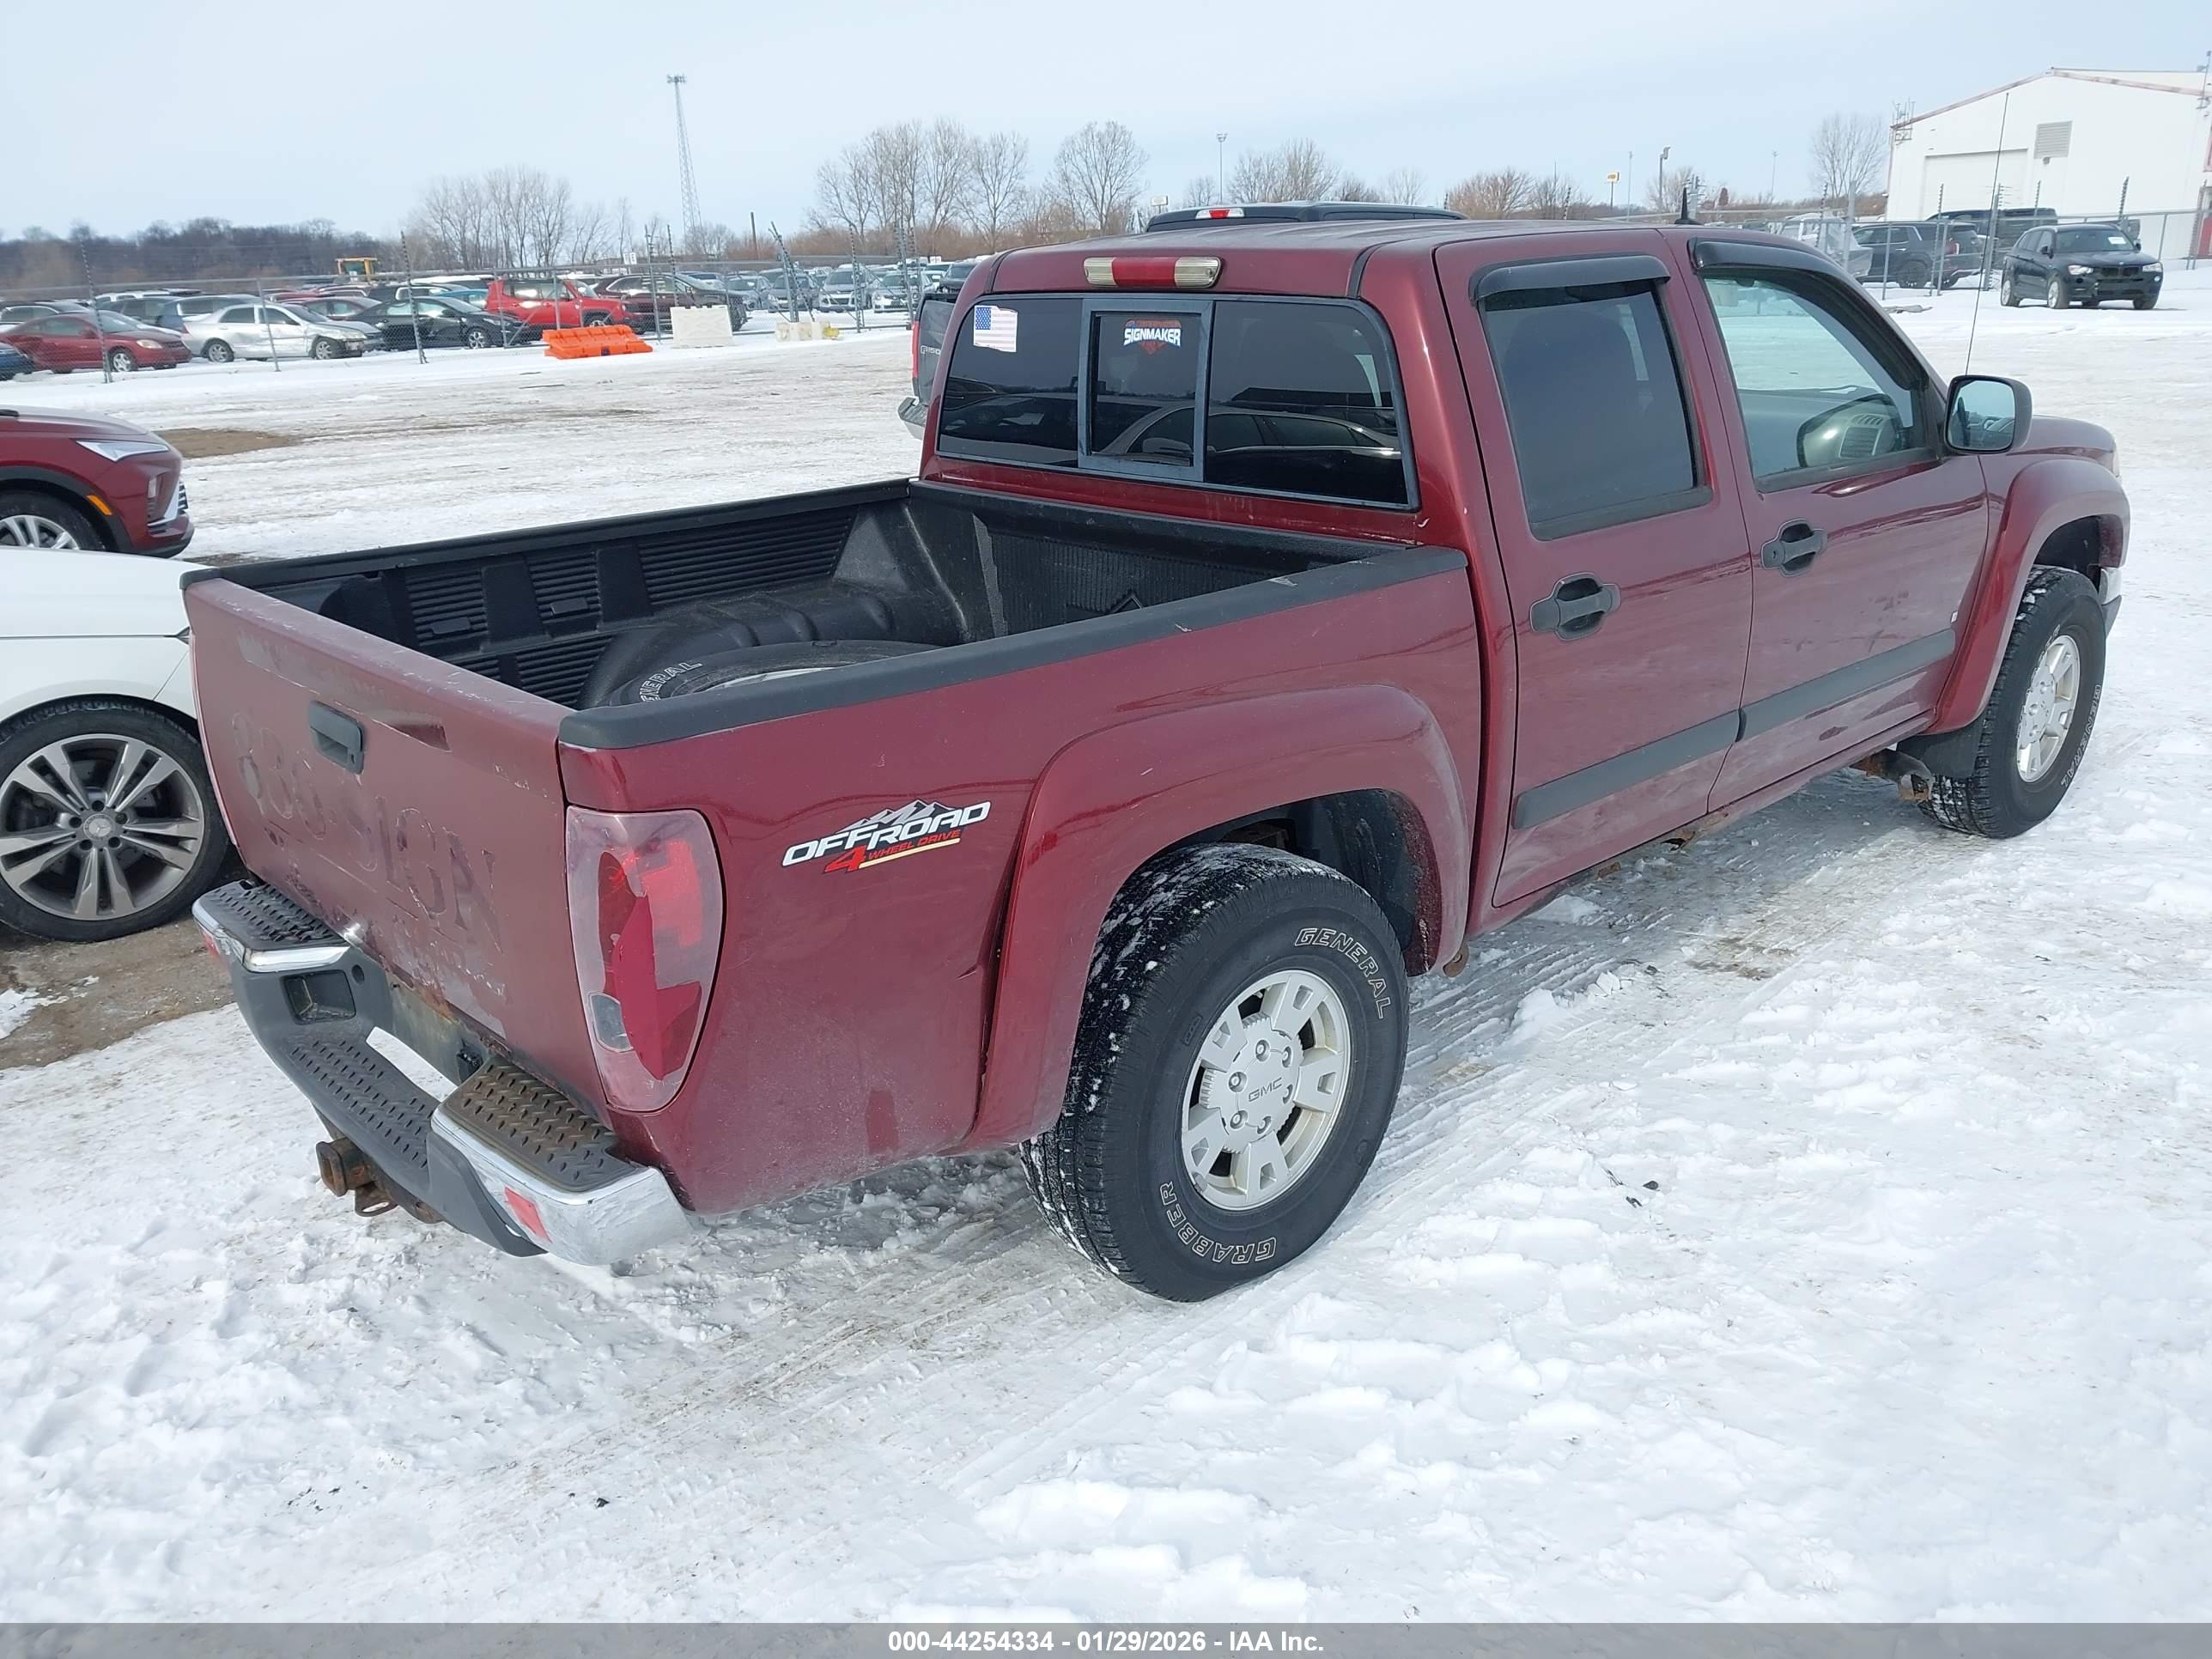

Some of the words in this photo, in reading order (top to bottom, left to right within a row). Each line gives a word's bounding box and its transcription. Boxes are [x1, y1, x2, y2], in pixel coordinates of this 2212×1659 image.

[1123, 327, 1182, 348] SIGNMAKER
[781, 800, 992, 867] OFFROAD
[823, 845, 867, 874] 4
[868, 842, 915, 860] WHEEL
[916, 829, 962, 847] DRIVE
[1294, 927, 1391, 1021] GENERAL
[1248, 1077, 1283, 1103] GMC
[1160, 1181, 1277, 1265] GRABBER
